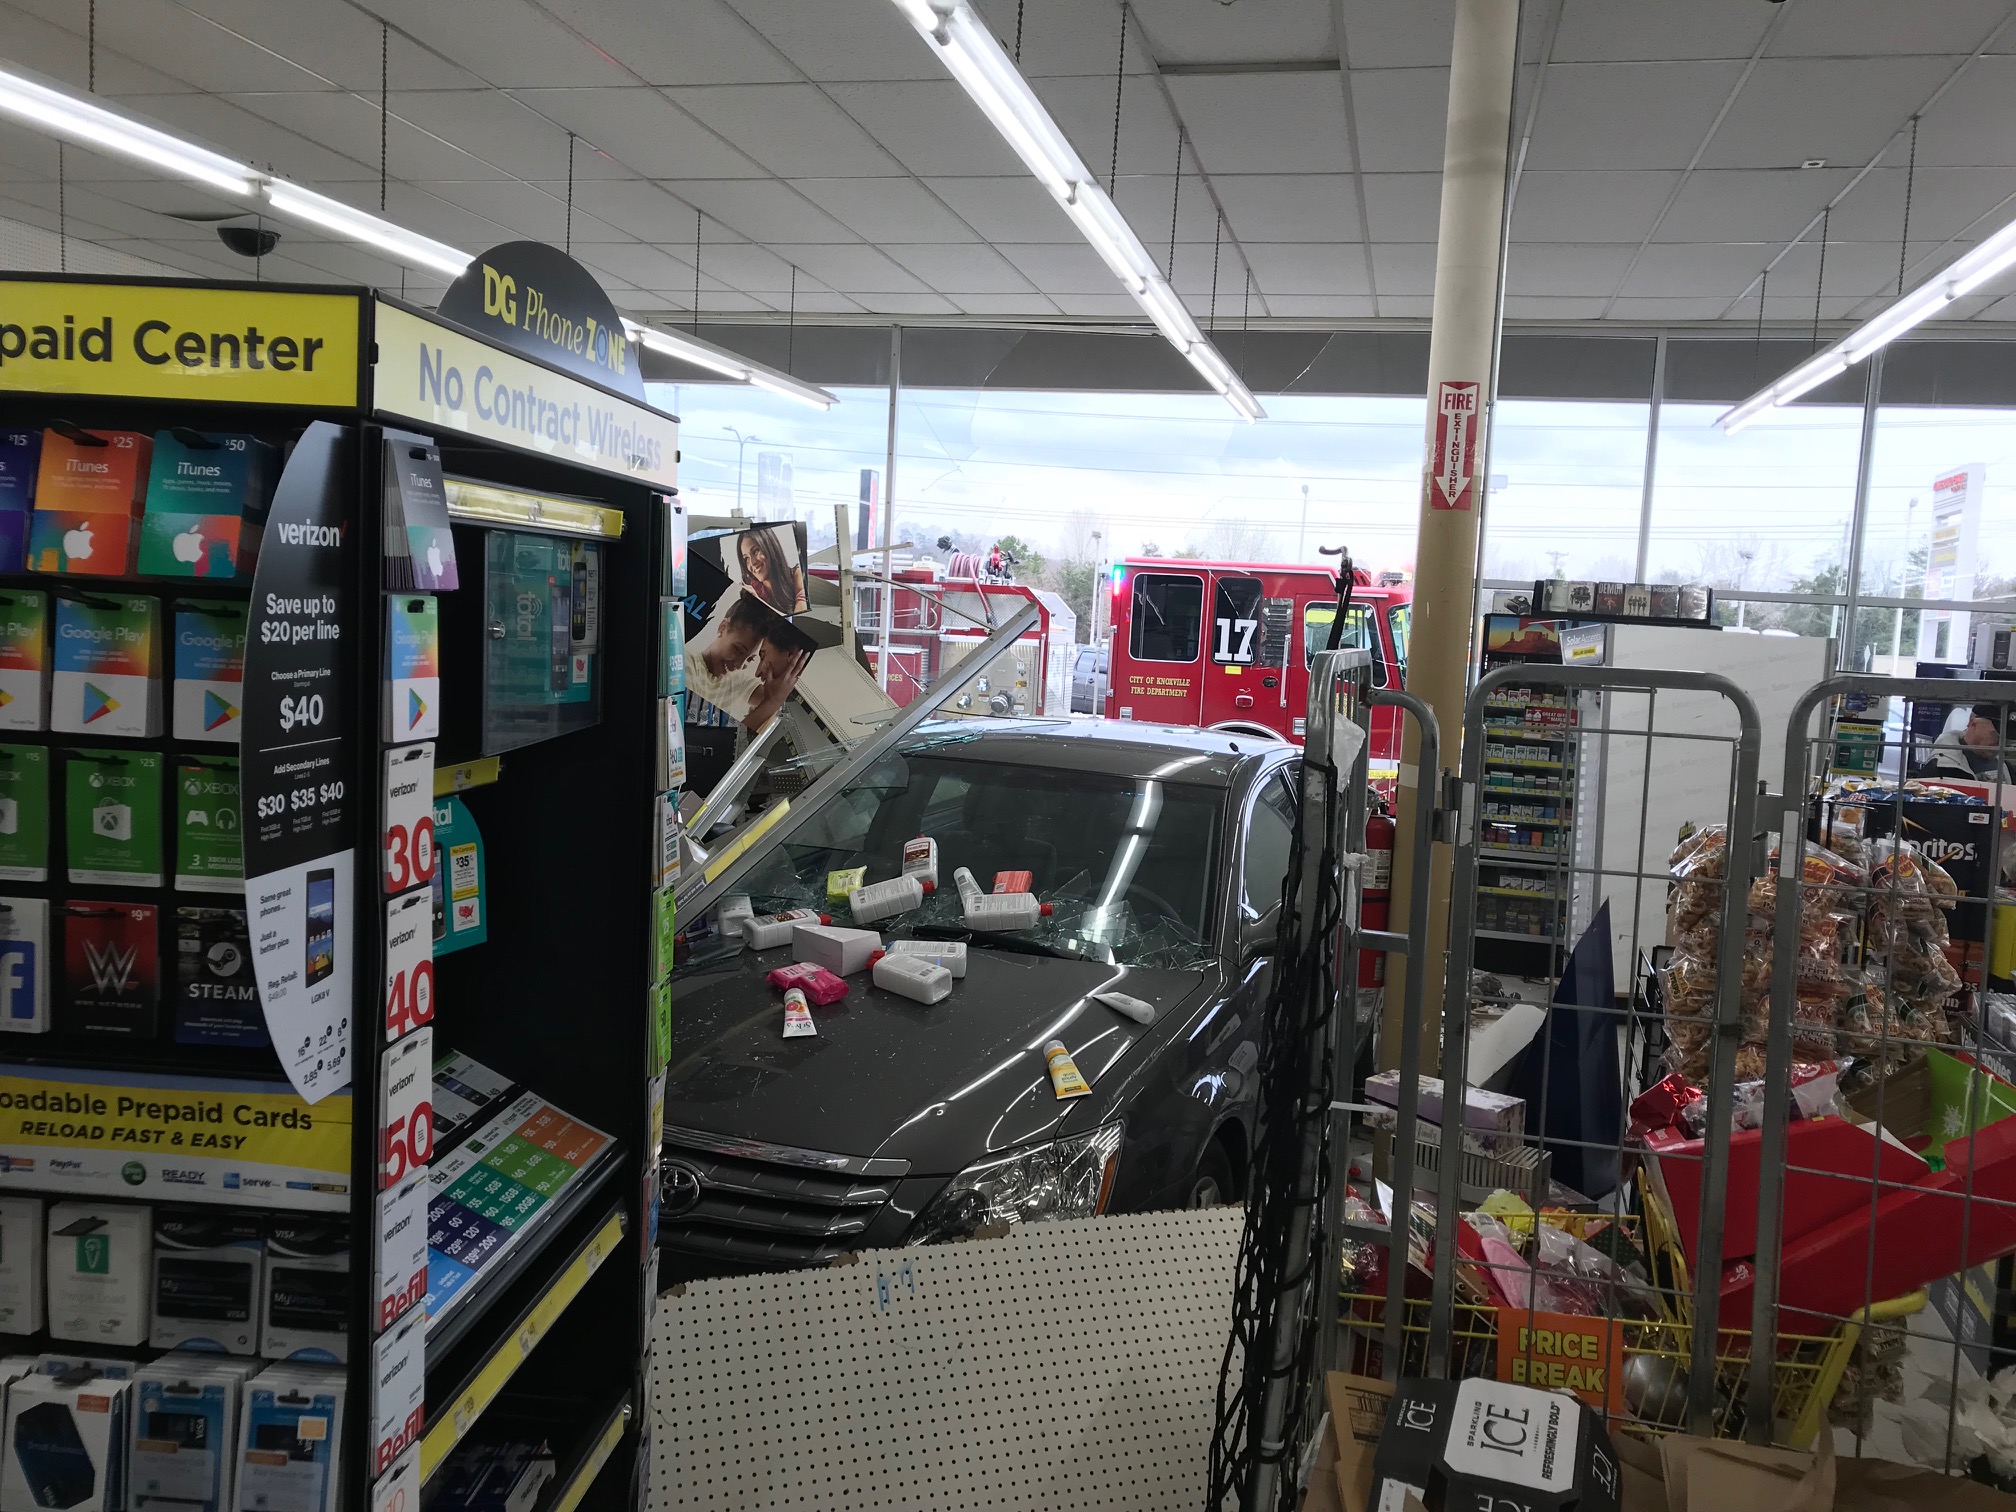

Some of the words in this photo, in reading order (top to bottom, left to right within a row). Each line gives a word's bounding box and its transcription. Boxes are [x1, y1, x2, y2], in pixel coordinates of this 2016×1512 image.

[483, 263, 517, 327] DG
[133, 320, 323, 372] Center
[419, 342, 464, 410] No
[474, 365, 580, 447] Contract
[587, 404, 661, 471] Wireless
[1444, 393, 1473, 410] FIRE
[113, 437, 134, 449] $25
[225, 439, 246, 451] $50
[1449, 413, 1461, 498] EXTINGUISHER
[66, 458, 109, 474] iTunes
[177, 461, 221, 477] iTunes
[410, 473, 432, 488] iTunes
[278, 518, 341, 547] verizon
[266, 593, 301, 614] Save
[303, 598, 320, 618] up
[322, 594, 336, 613] to
[7, 622, 37, 640] Play
[60, 623, 114, 643] Google
[115, 627, 145, 645] Play
[260, 620, 291, 645] $20
[292, 624, 316, 645] per
[317, 620, 340, 640] line
[180, 631, 233, 650] Google
[1214, 618, 1257, 662] 17
[1566, 634, 1581, 646] Solar
[271, 670, 293, 681] Choose
[297, 669, 320, 679] Primary
[320, 668, 331, 676] Line
[1129, 676, 1144, 684] CITY
[1156, 677, 1190, 687] KNOXVILLE
[1130, 686, 1145, 695] FIRE
[1147, 687, 1188, 697] DEPARTMENT
[279, 694, 324, 733] $40
[140, 758, 155, 767] $25
[273, 764, 287, 775] Add
[286, 760, 316, 773] Secondary
[315, 757, 330, 767] Lines
[104, 776, 136, 787] XBOX
[203, 782, 239, 795] XBOX
[389, 782, 416, 798] verizon
[257, 793, 285, 819] $30
[290, 787, 316, 811] $35
[319, 781, 344, 805] $40
[191, 854, 200, 866] 3
[456, 856, 470, 868] $35
[260, 893, 276, 904] Same
[276, 888, 292, 900] great
[260, 932, 273, 942] Just
[389, 930, 414, 949] verizon
[259, 943, 277, 955] better
[188, 982, 255, 1001] STEAM
[267, 980, 280, 990] Reg.
[318, 1034, 327, 1047] 22
[388, 1073, 414, 1098] verizon
[117, 1096, 223, 1124] Prepaid
[233, 1103, 312, 1130] Cards
[19, 1120, 105, 1140] RELOAD
[110, 1127, 165, 1145] FAST
[170, 1131, 184, 1146] &
[190, 1133, 247, 1150] EASY
[162, 1168, 205, 1180] READY
[450, 1188, 466, 1200] $25
[428, 1207, 446, 1222] 200
[448, 1217, 463, 1228] 60
[162, 1222, 183, 1232] VISA
[275, 1229, 295, 1239] VISA
[383, 1213, 411, 1243] verizon
[462, 1226, 480, 1240] 120
[479, 1235, 497, 1250] 200
[381, 1264, 428, 1329] Refill
[1518, 1327, 1599, 1360] PRICE
[380, 1355, 407, 1388] verizon
[1512, 1358, 1605, 1393] BREAK
[1404, 1399, 1436, 1432] ICE
[1467, 1400, 1482, 1447] SPARKLING
[377, 1402, 424, 1475] Refill
[1480, 1403, 1530, 1457] ICE
